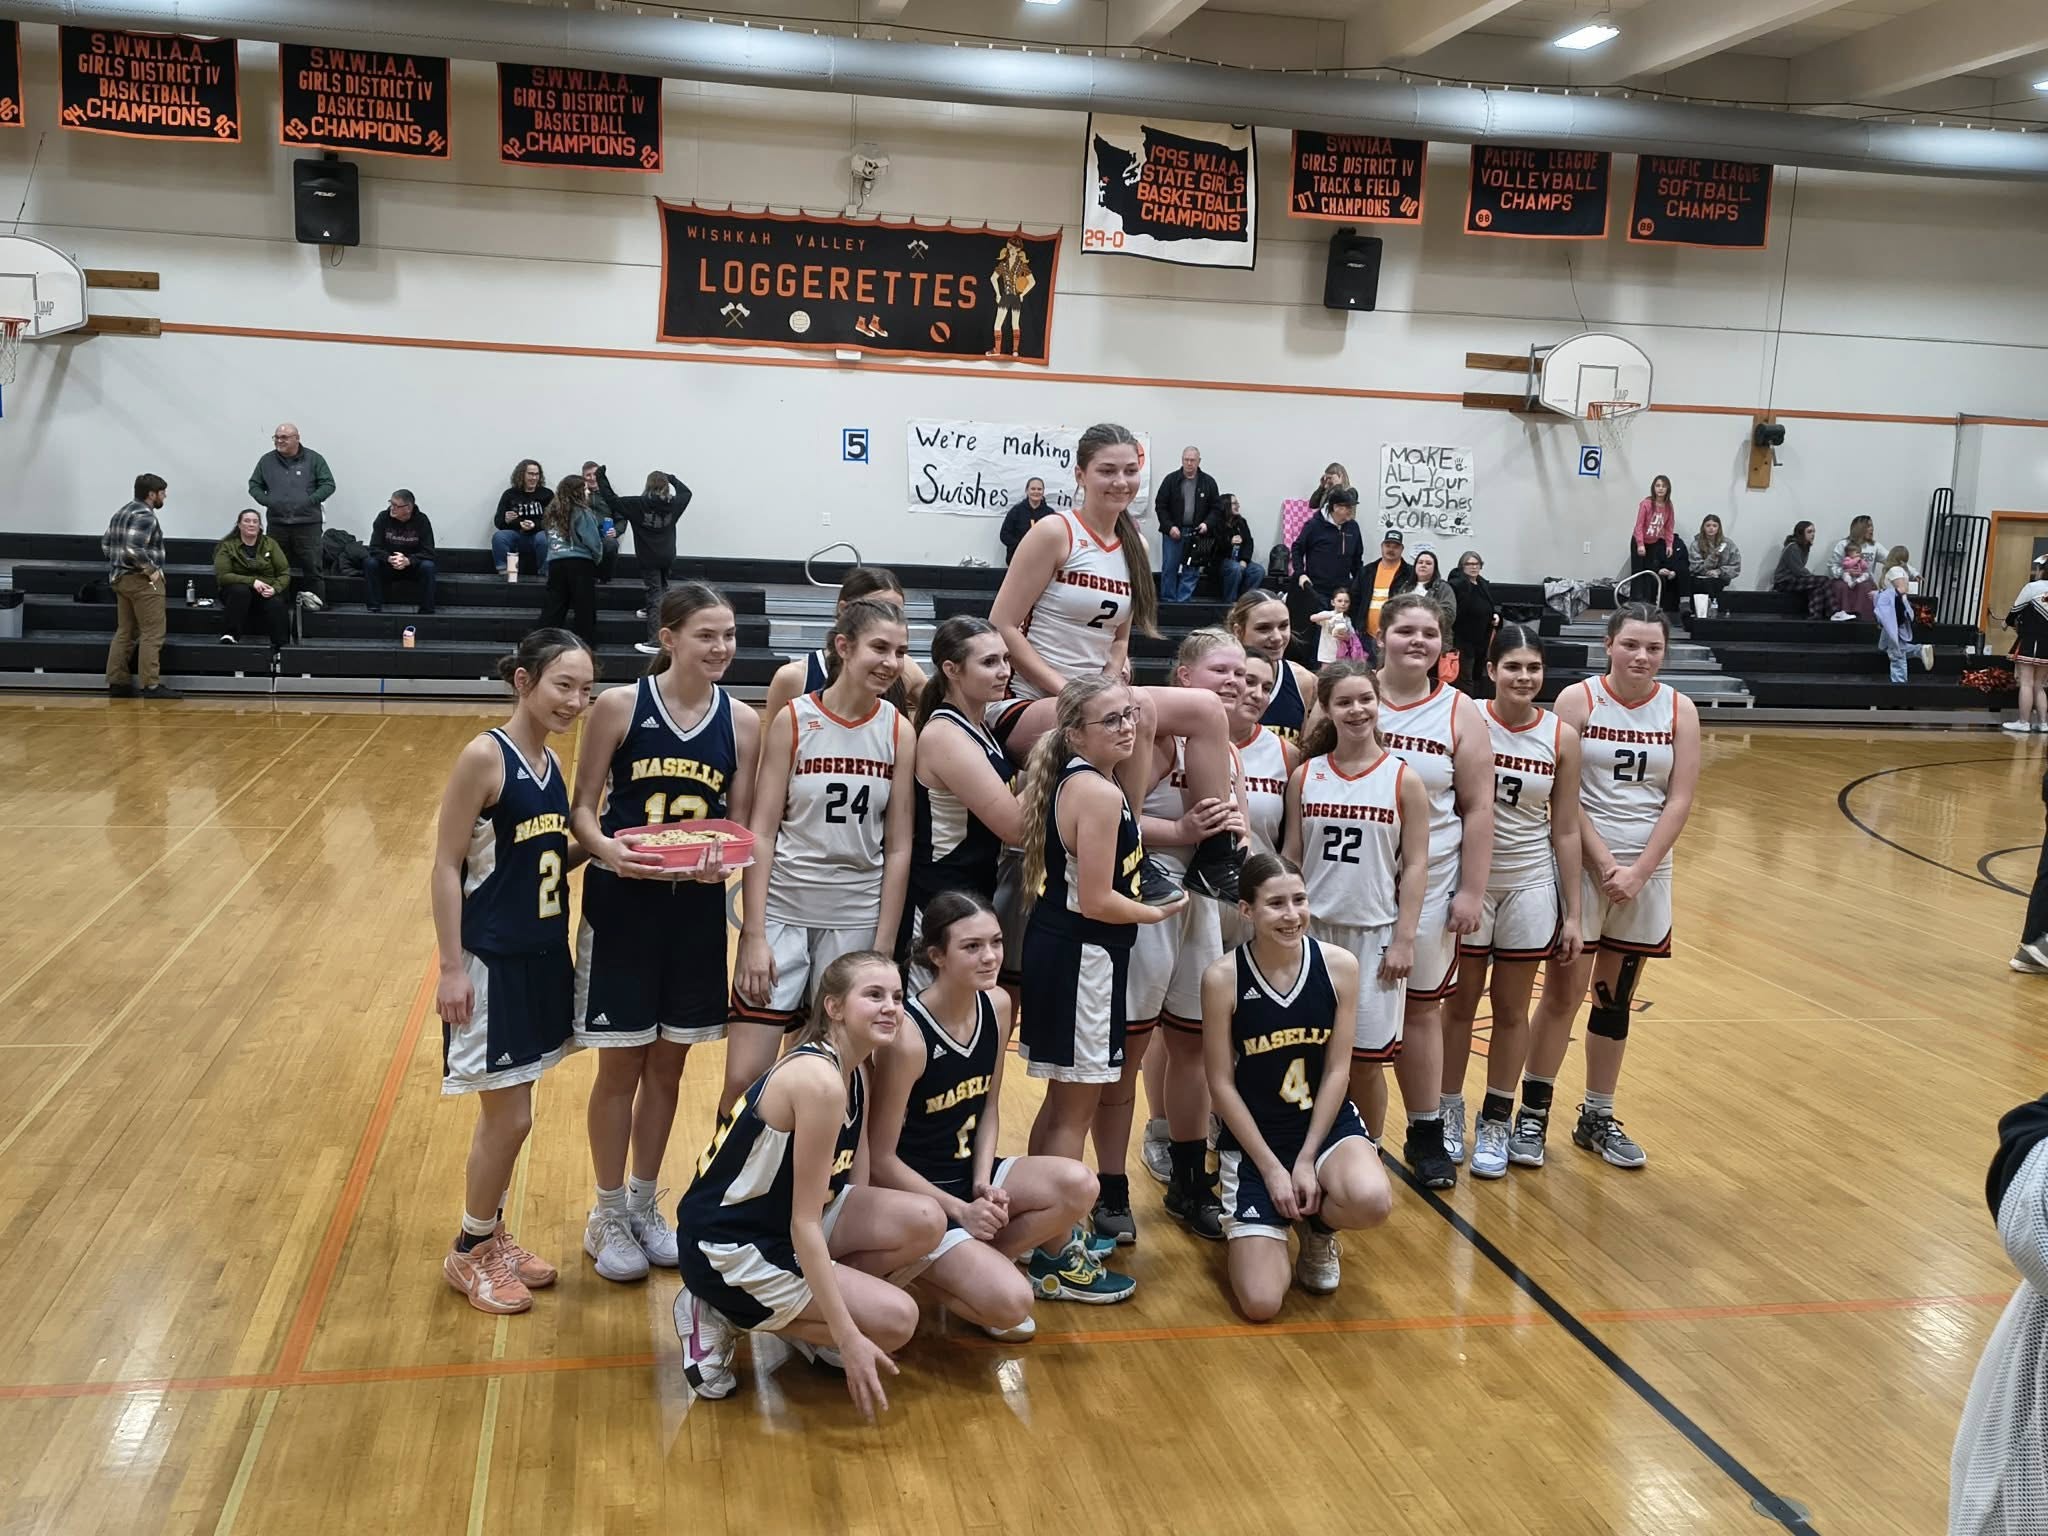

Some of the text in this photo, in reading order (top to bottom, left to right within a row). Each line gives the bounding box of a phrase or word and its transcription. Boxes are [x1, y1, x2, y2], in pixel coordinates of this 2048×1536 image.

[91, 33, 210, 63] S.W.W.I.A.A.
[78, 53, 221, 85] GIRLS DISTRICT IV
[310, 48, 422, 79] S.W.W.I.A.A.
[100, 78, 200, 105] BASKETBALL
[299, 70, 433, 101] GIRLS DISTRICT IV
[86, 98, 211, 127] CHAMPIONS
[317, 94, 414, 122] BASKETBALL
[513, 87, 645, 114] GIRLS DISTRICT IV
[64, 104, 87, 126] 94
[213, 114, 237, 138] 95
[534, 111, 627, 135] BASKETBALL
[285, 118, 308, 140] 93
[311, 116, 422, 145] CHAMPIONS
[424, 130, 446, 153] 94
[526, 132, 635, 157] CHAMPIONS
[639, 145, 658, 169] 93
[1150, 144, 1189, 168] 1995
[1302, 153, 1414, 177] GIRLS DISTRICT IV
[1483, 148, 1599, 170] PACIFIC LEAGUE
[1652, 157, 1761, 183] PACIFIC LEAGUE
[1143, 163, 1245, 195] STATE GIRLS
[1313, 175, 1400, 197] TRACK & FIELD
[1480, 168, 1597, 190] VOLLEYBALL
[1658, 178, 1751, 201] SOFTBALL
[1137, 182, 1248, 213] BASKETBALL
[1321, 196, 1390, 217] CHAMPIONS
[1500, 191, 1574, 211] CHAMPS
[1666, 200, 1739, 221] CHAMPS
[1141, 203, 1241, 231] CHAMPIONS
[686, 225, 866, 252] WISHKAH VALLEY
[1084, 229, 1124, 248] 29-0
[699, 258, 978, 310] LOGGERETTES
[847, 432, 866, 459] 5
[915, 426, 977, 452] We're
[1385, 464, 1426, 484] ALL
[1583, 450, 1600, 471] 6
[915, 463, 1073, 509] Swishes in
[1055, 570, 1132, 596] LOGGERET
[1087, 600, 1119, 629] 2
[1583, 725, 1673, 745] LOGGERETTE
[631, 757, 724, 792] NASELLE
[1614, 749, 1647, 782] 21
[825, 783, 870, 824] 24
[1301, 803, 1395, 825] LOGGERETTES
[514, 813, 570, 843] NASELL
[1322, 825, 1363, 864] 22
[538, 849, 562, 919] 2
[926, 1074, 992, 1115] NASELL
[1279, 1057, 1313, 1110] 4
